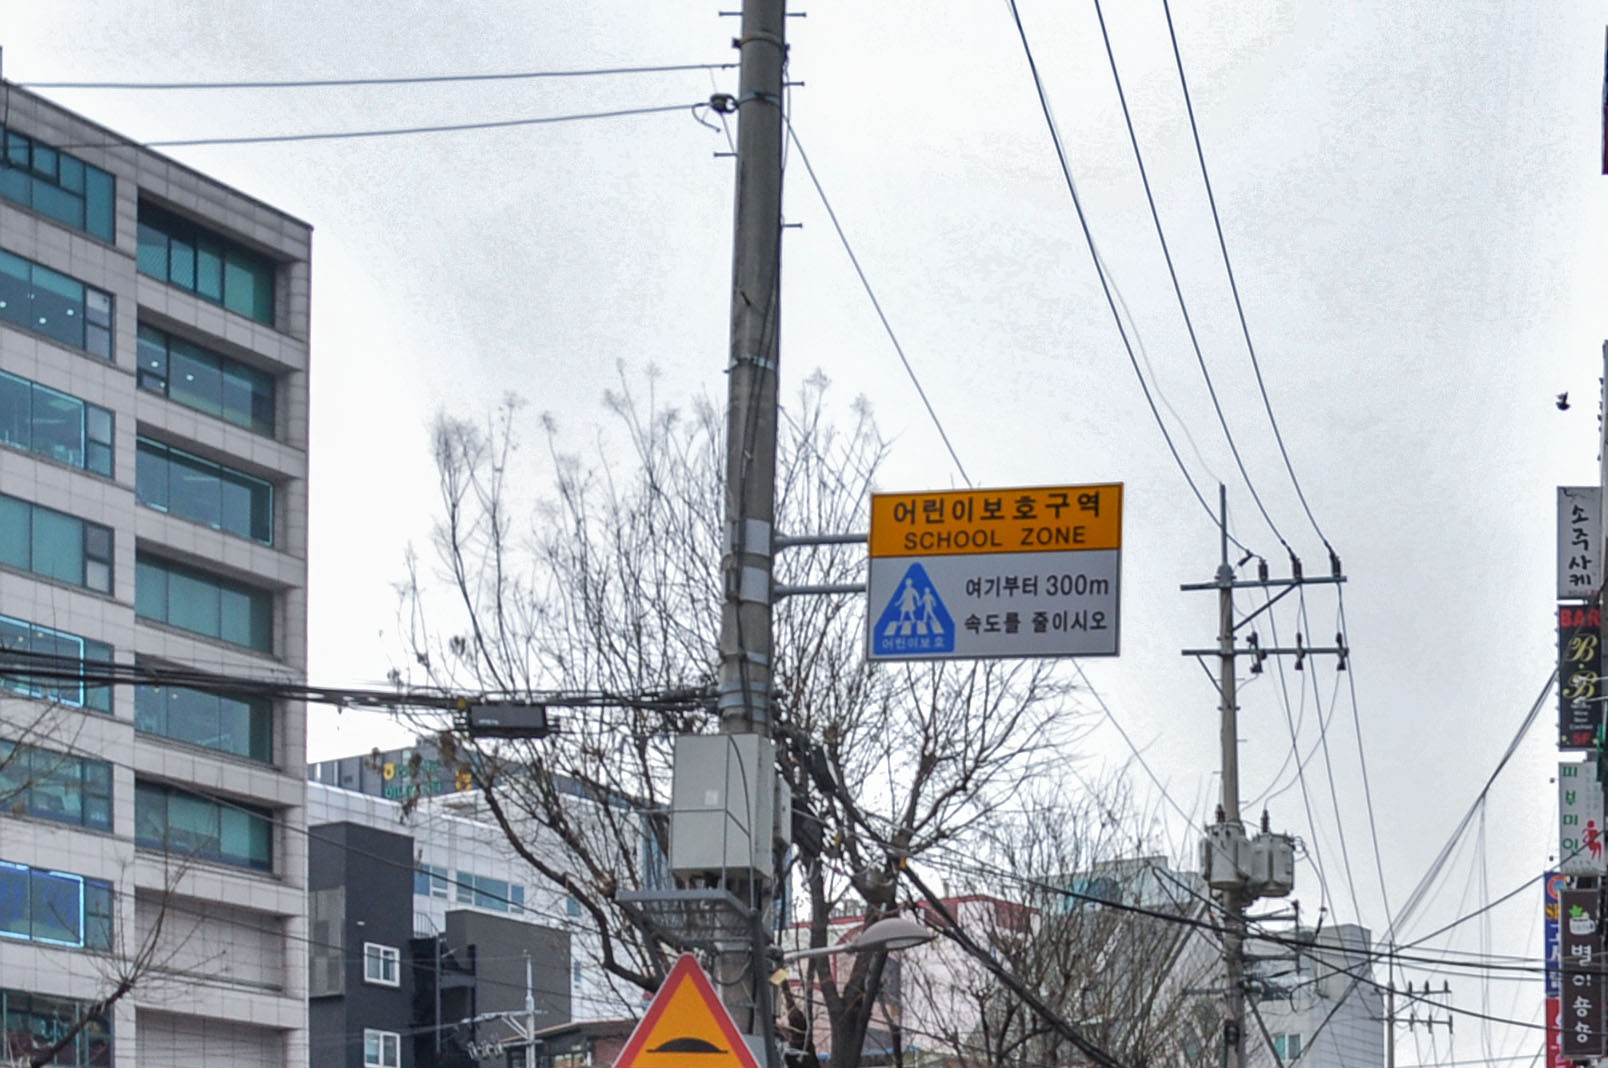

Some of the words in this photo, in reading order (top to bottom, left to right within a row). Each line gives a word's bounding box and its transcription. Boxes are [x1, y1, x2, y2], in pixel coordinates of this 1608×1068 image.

[893, 491, 1101, 525] 어린이보호구역
[904, 529, 1003, 551] SCHOOL
[1020, 526, 1086, 547] ZONE
[1568, 504, 1592, 587] 소주사케
[965, 575, 1039, 599] 여기부터
[1045, 573, 1110, 597] 300m
[964, 611, 1022, 634] 속도를
[1031, 609, 1108, 634] 줄이시오
[882, 635, 945, 650] 어린이보호
